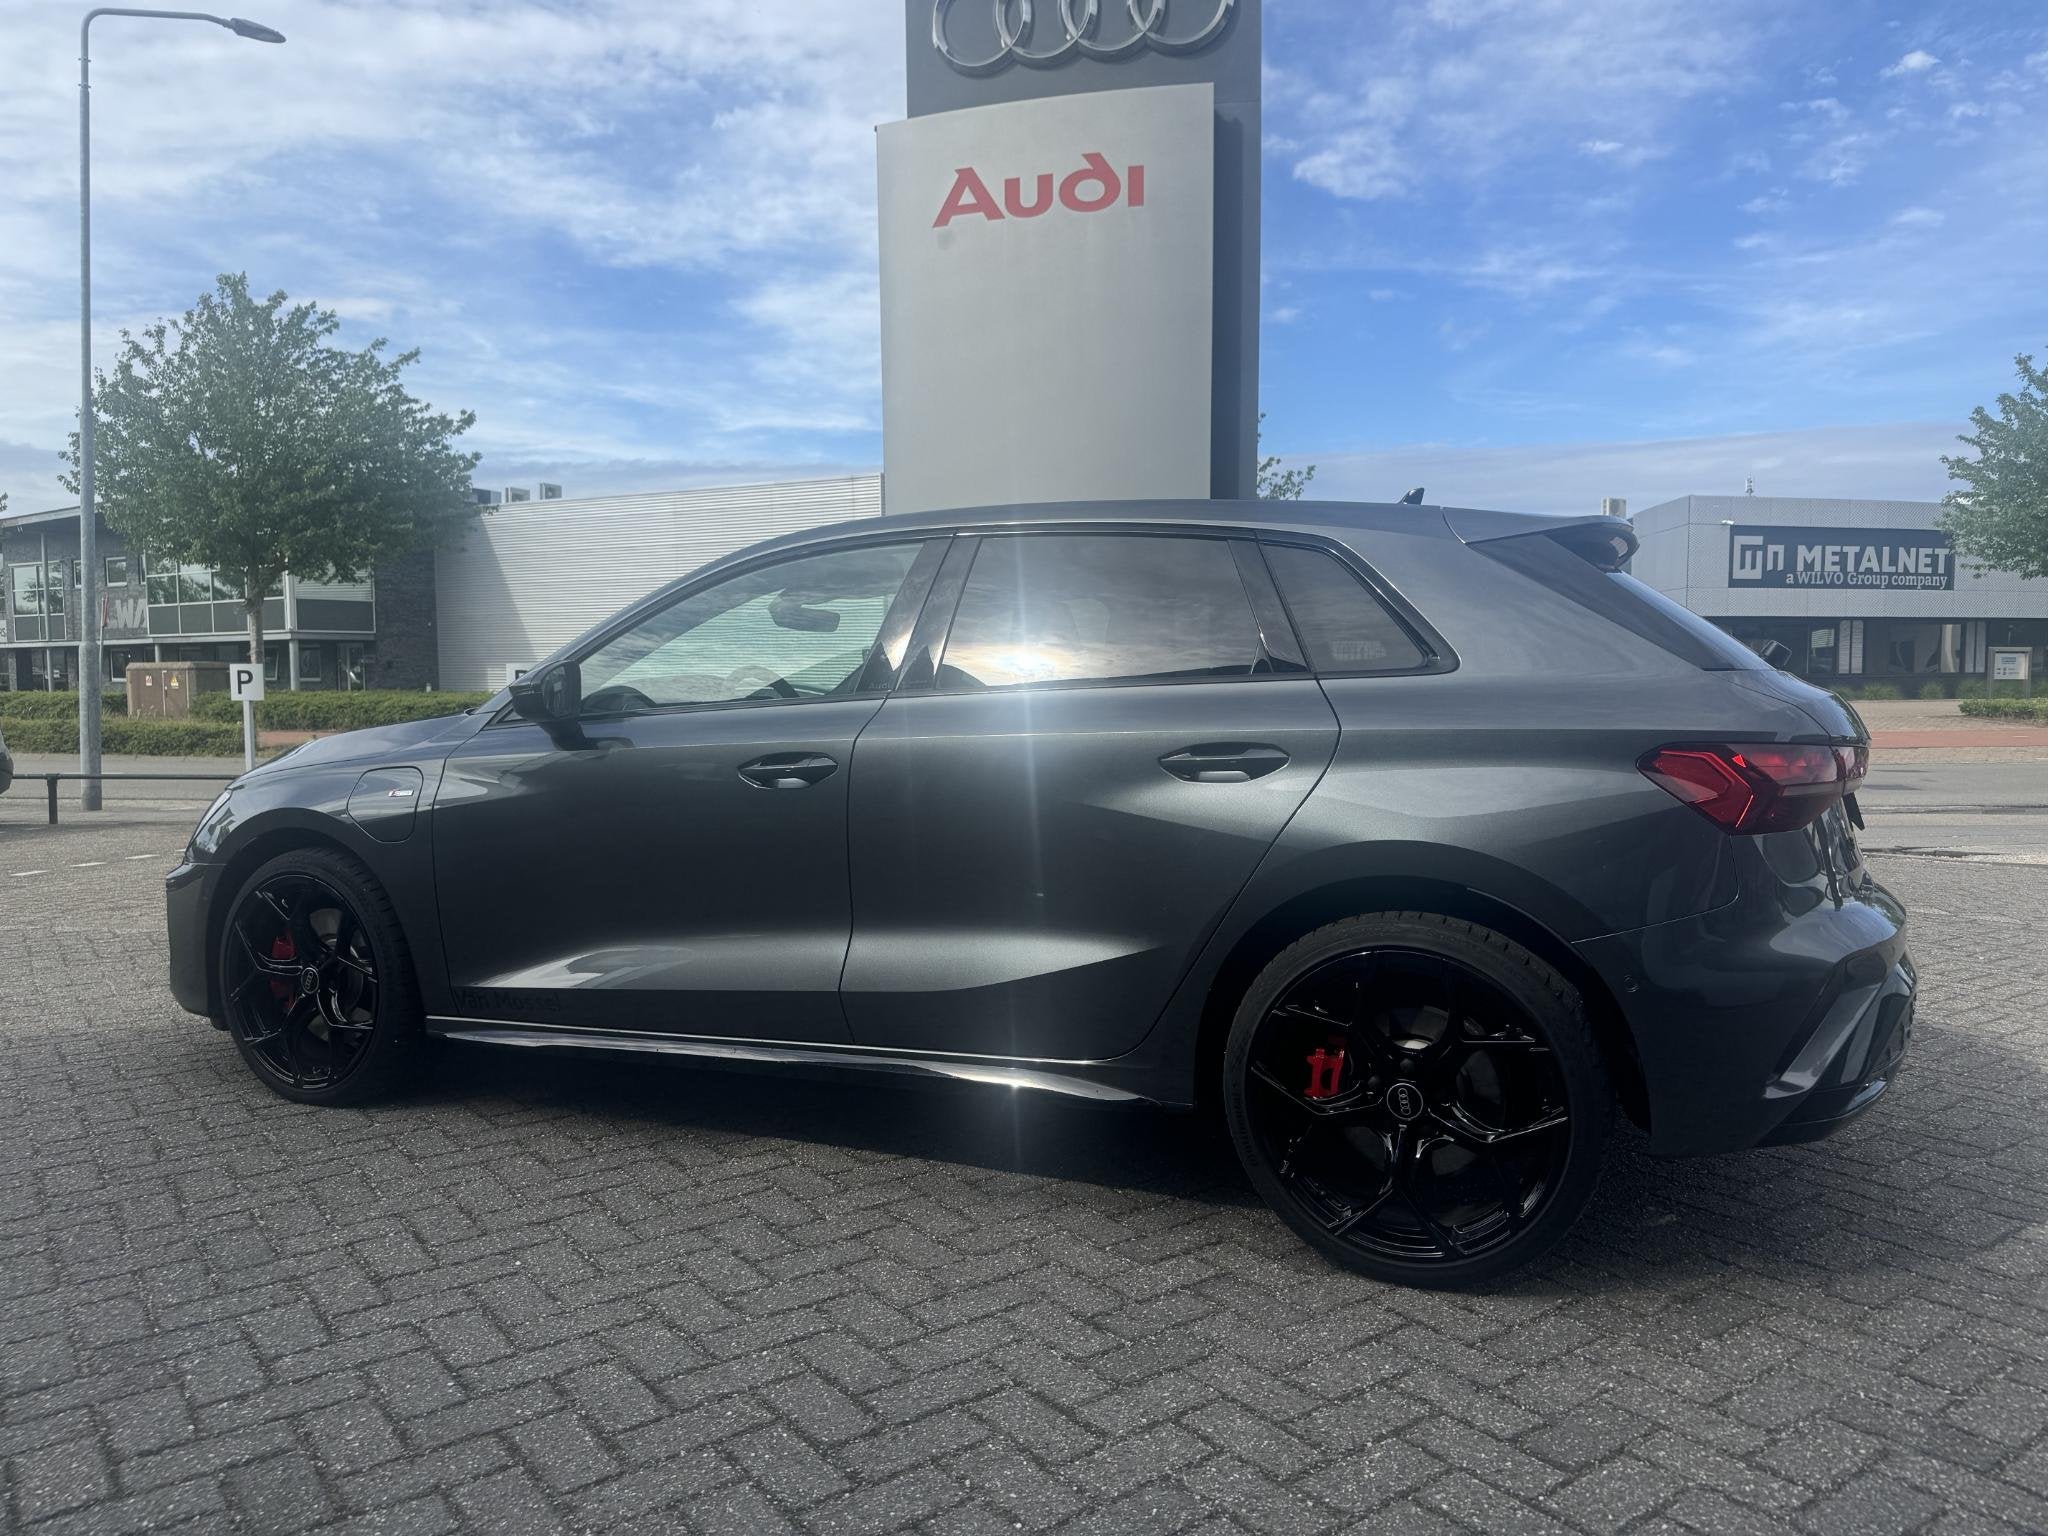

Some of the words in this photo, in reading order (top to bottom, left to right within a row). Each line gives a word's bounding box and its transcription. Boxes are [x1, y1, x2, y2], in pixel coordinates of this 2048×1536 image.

[932, 152, 1144, 228] Audi
[1796, 544, 1950, 574] METALNET
[1786, 573, 1794, 584] a
[1797, 571, 1844, 585] WILVO
[1847, 572, 1888, 589] Group
[1891, 575, 1948, 590] company
[237, 669, 254, 694] P
